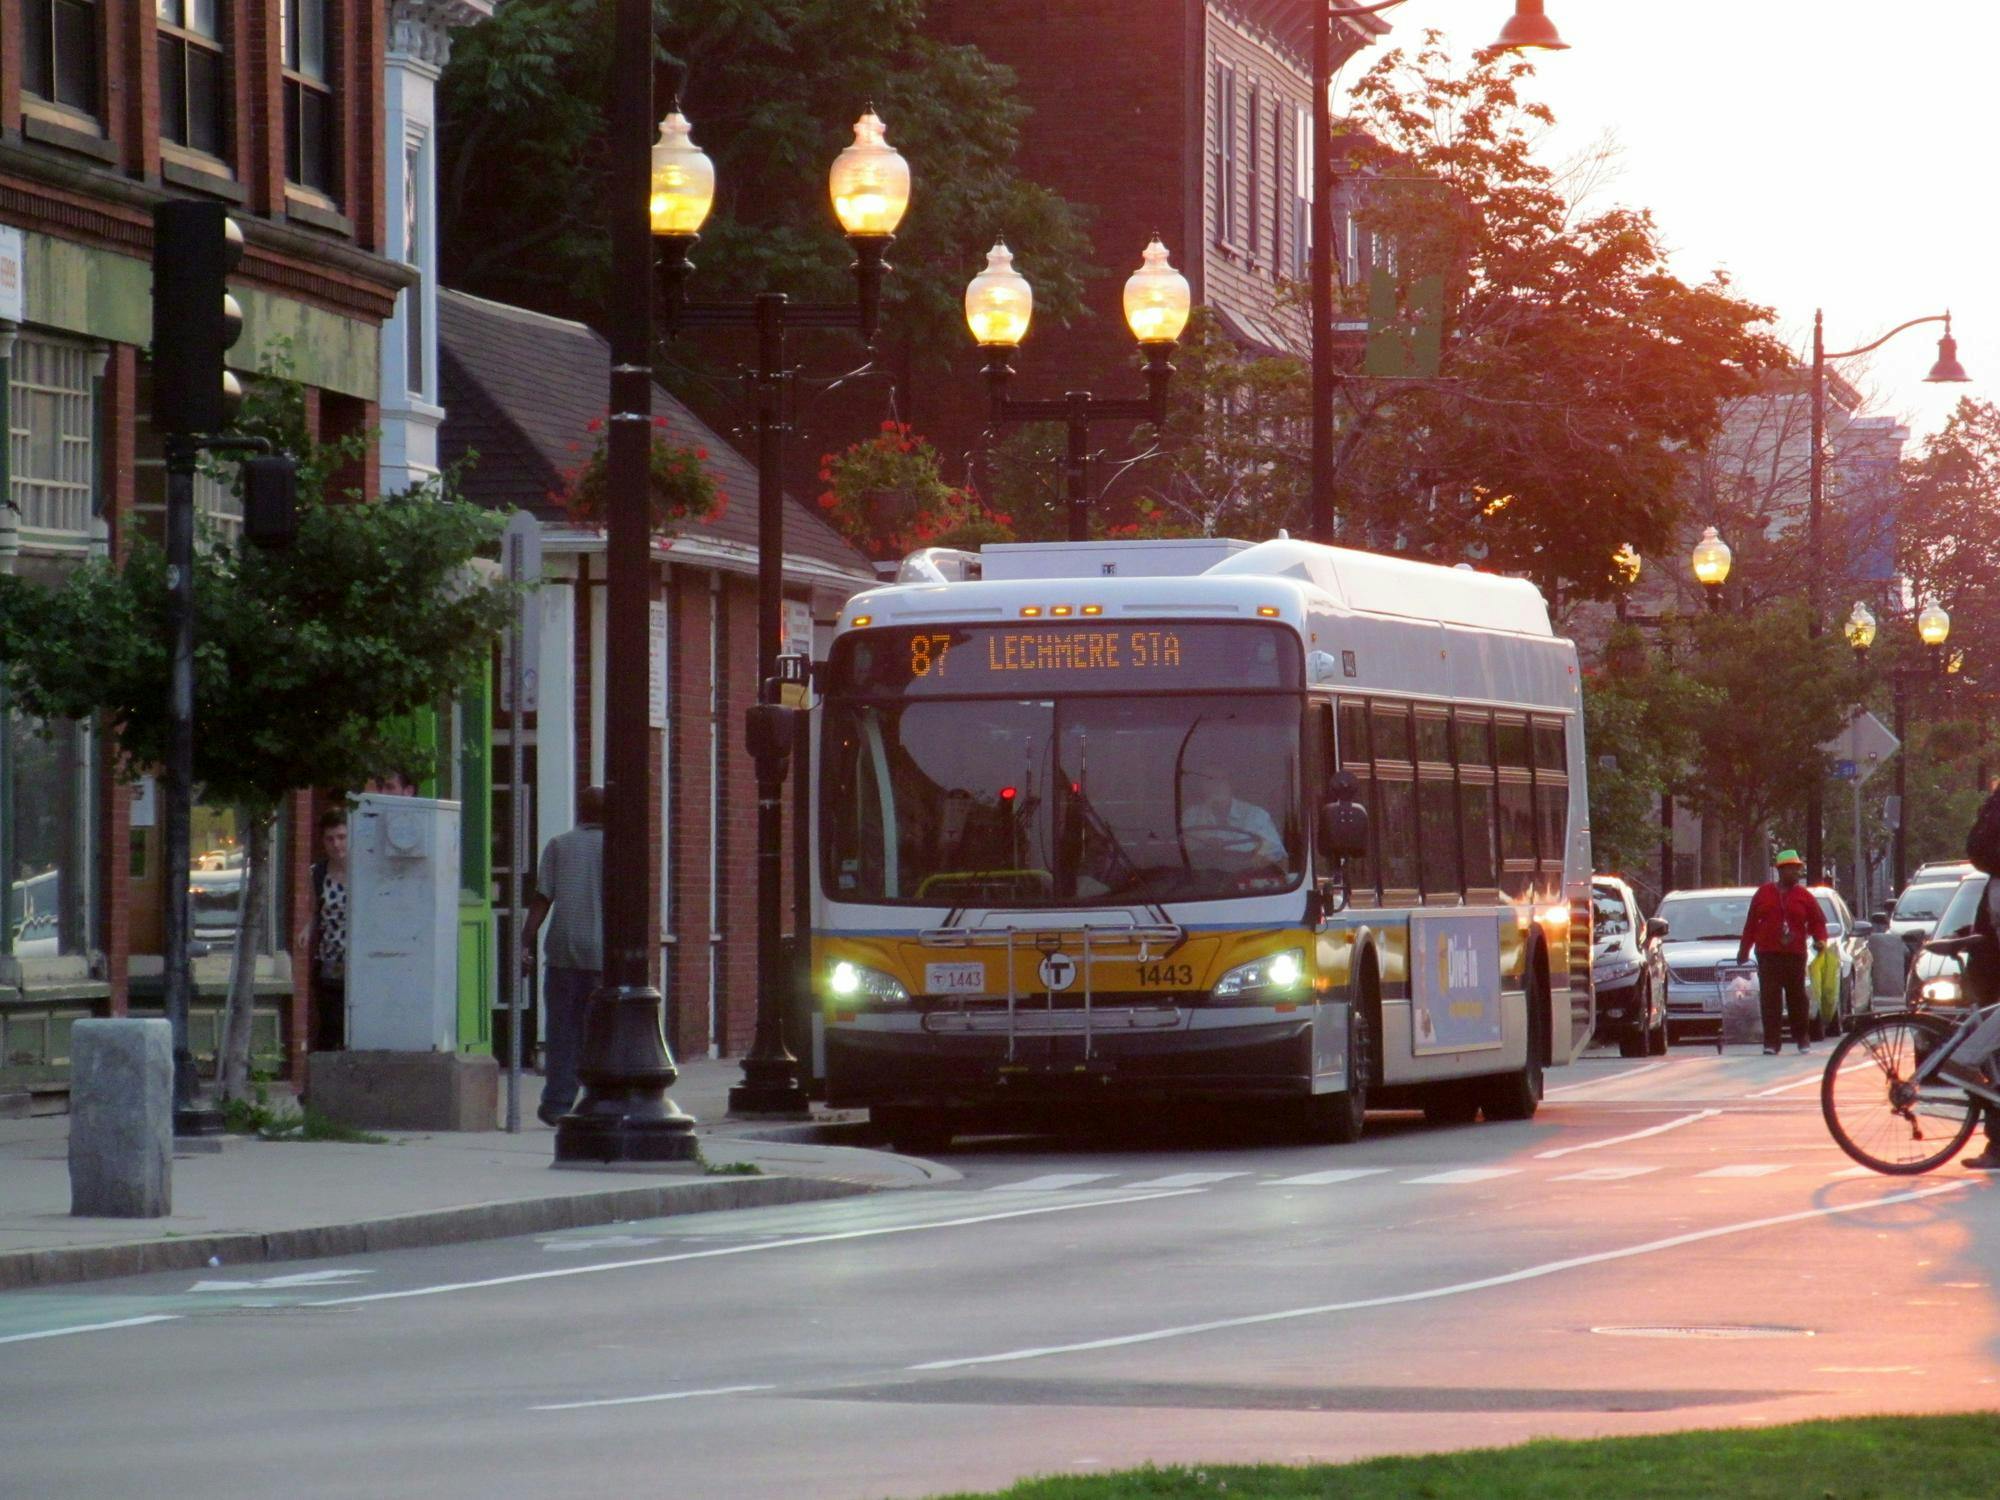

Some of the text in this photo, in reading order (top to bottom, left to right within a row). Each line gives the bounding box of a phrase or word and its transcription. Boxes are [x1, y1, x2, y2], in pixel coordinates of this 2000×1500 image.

[911, 631, 1180, 677] 87 LECHMERE STA
[949, 971, 981, 987] 1443
[1136, 965, 1193, 987] 1443
